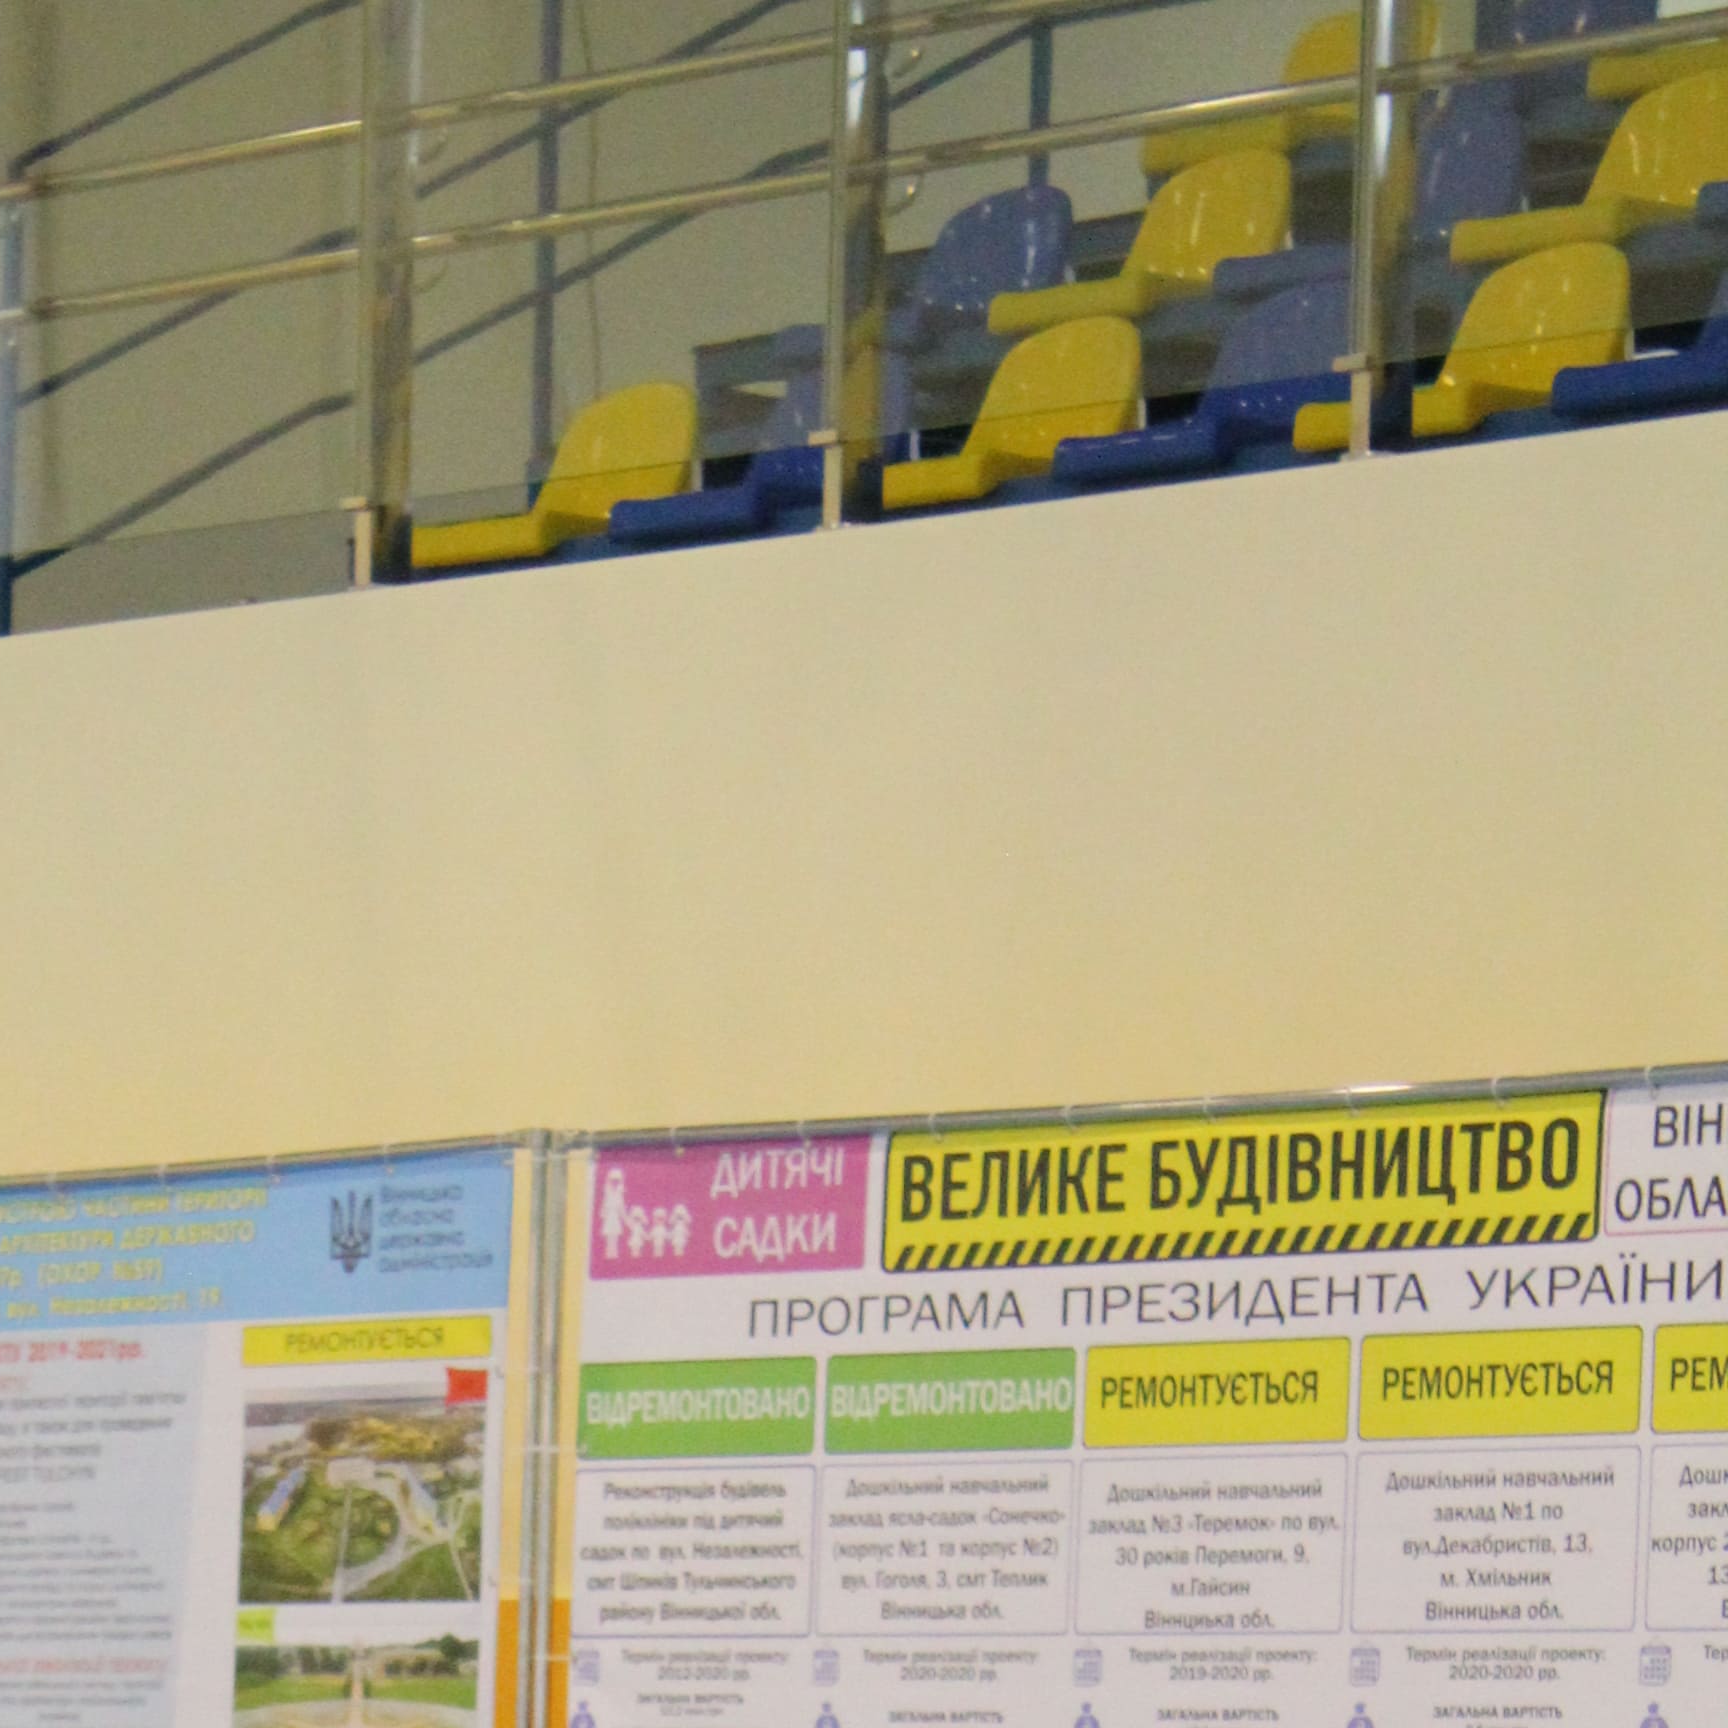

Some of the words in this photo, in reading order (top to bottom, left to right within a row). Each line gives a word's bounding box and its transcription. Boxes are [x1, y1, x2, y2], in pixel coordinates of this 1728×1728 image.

[1653, 1103, 1723, 1148] ВІН
[710, 1147, 843, 1199] ДИТЯЧІ
[900, 1143, 1127, 1223] ВЕЛИКЕ
[1149, 1117, 1581, 1217] БУДІВНИЦТВО
[1614, 1174, 1727, 1222] ОБЛА
[714, 1213, 836, 1263] САДКИ
[748, 1289, 1025, 1338] ПРОГРАМА
[1059, 1270, 1429, 1328] ПРЕЗИДЕНТА
[1466, 1251, 1725, 1311] УКРАЇНИ
[285, 1326, 444, 1353] РЕМОНТУЄТЬСЯ
[1101, 1371, 1319, 1410] РЕМОНТУЄТЬСЯ
[1382, 1360, 1614, 1401] РЕМОНТУЄТЬСЯ
[585, 1385, 811, 1429] ВІДРЕМОНТОВАНО
[832, 1377, 1072, 1420] ВІДРЕМОНТОВАНО
[1107, 1479, 1211, 1505] Дошкільний
[1217, 1476, 1322, 1499] навчальний
[1385, 1469, 1497, 1492] Дошкільний
[1503, 1465, 1615, 1488] навчальний
[1089, 1517, 1147, 1535] заклад
[1151, 1515, 1183, 1534] №3
[1280, 1516, 1303, 1531] по
[1433, 1506, 1497, 1523] заклад
[1501, 1501, 1535, 1521] №1
[1541, 1504, 1564, 1520] по
[1115, 1547, 1138, 1566] 30
[1143, 1547, 1189, 1568] років
[1651, 1536, 1718, 1556] корпус
[1465, 1568, 1553, 1589] Хмільник
[1425, 1600, 1521, 1622] Вінницька
[1527, 1600, 1564, 1621] обл.
[1405, 1644, 1457, 1664] Термін
[1462, 1644, 1537, 1665] реалізації
[1448, 1664, 1535, 1682] 2020-2020
